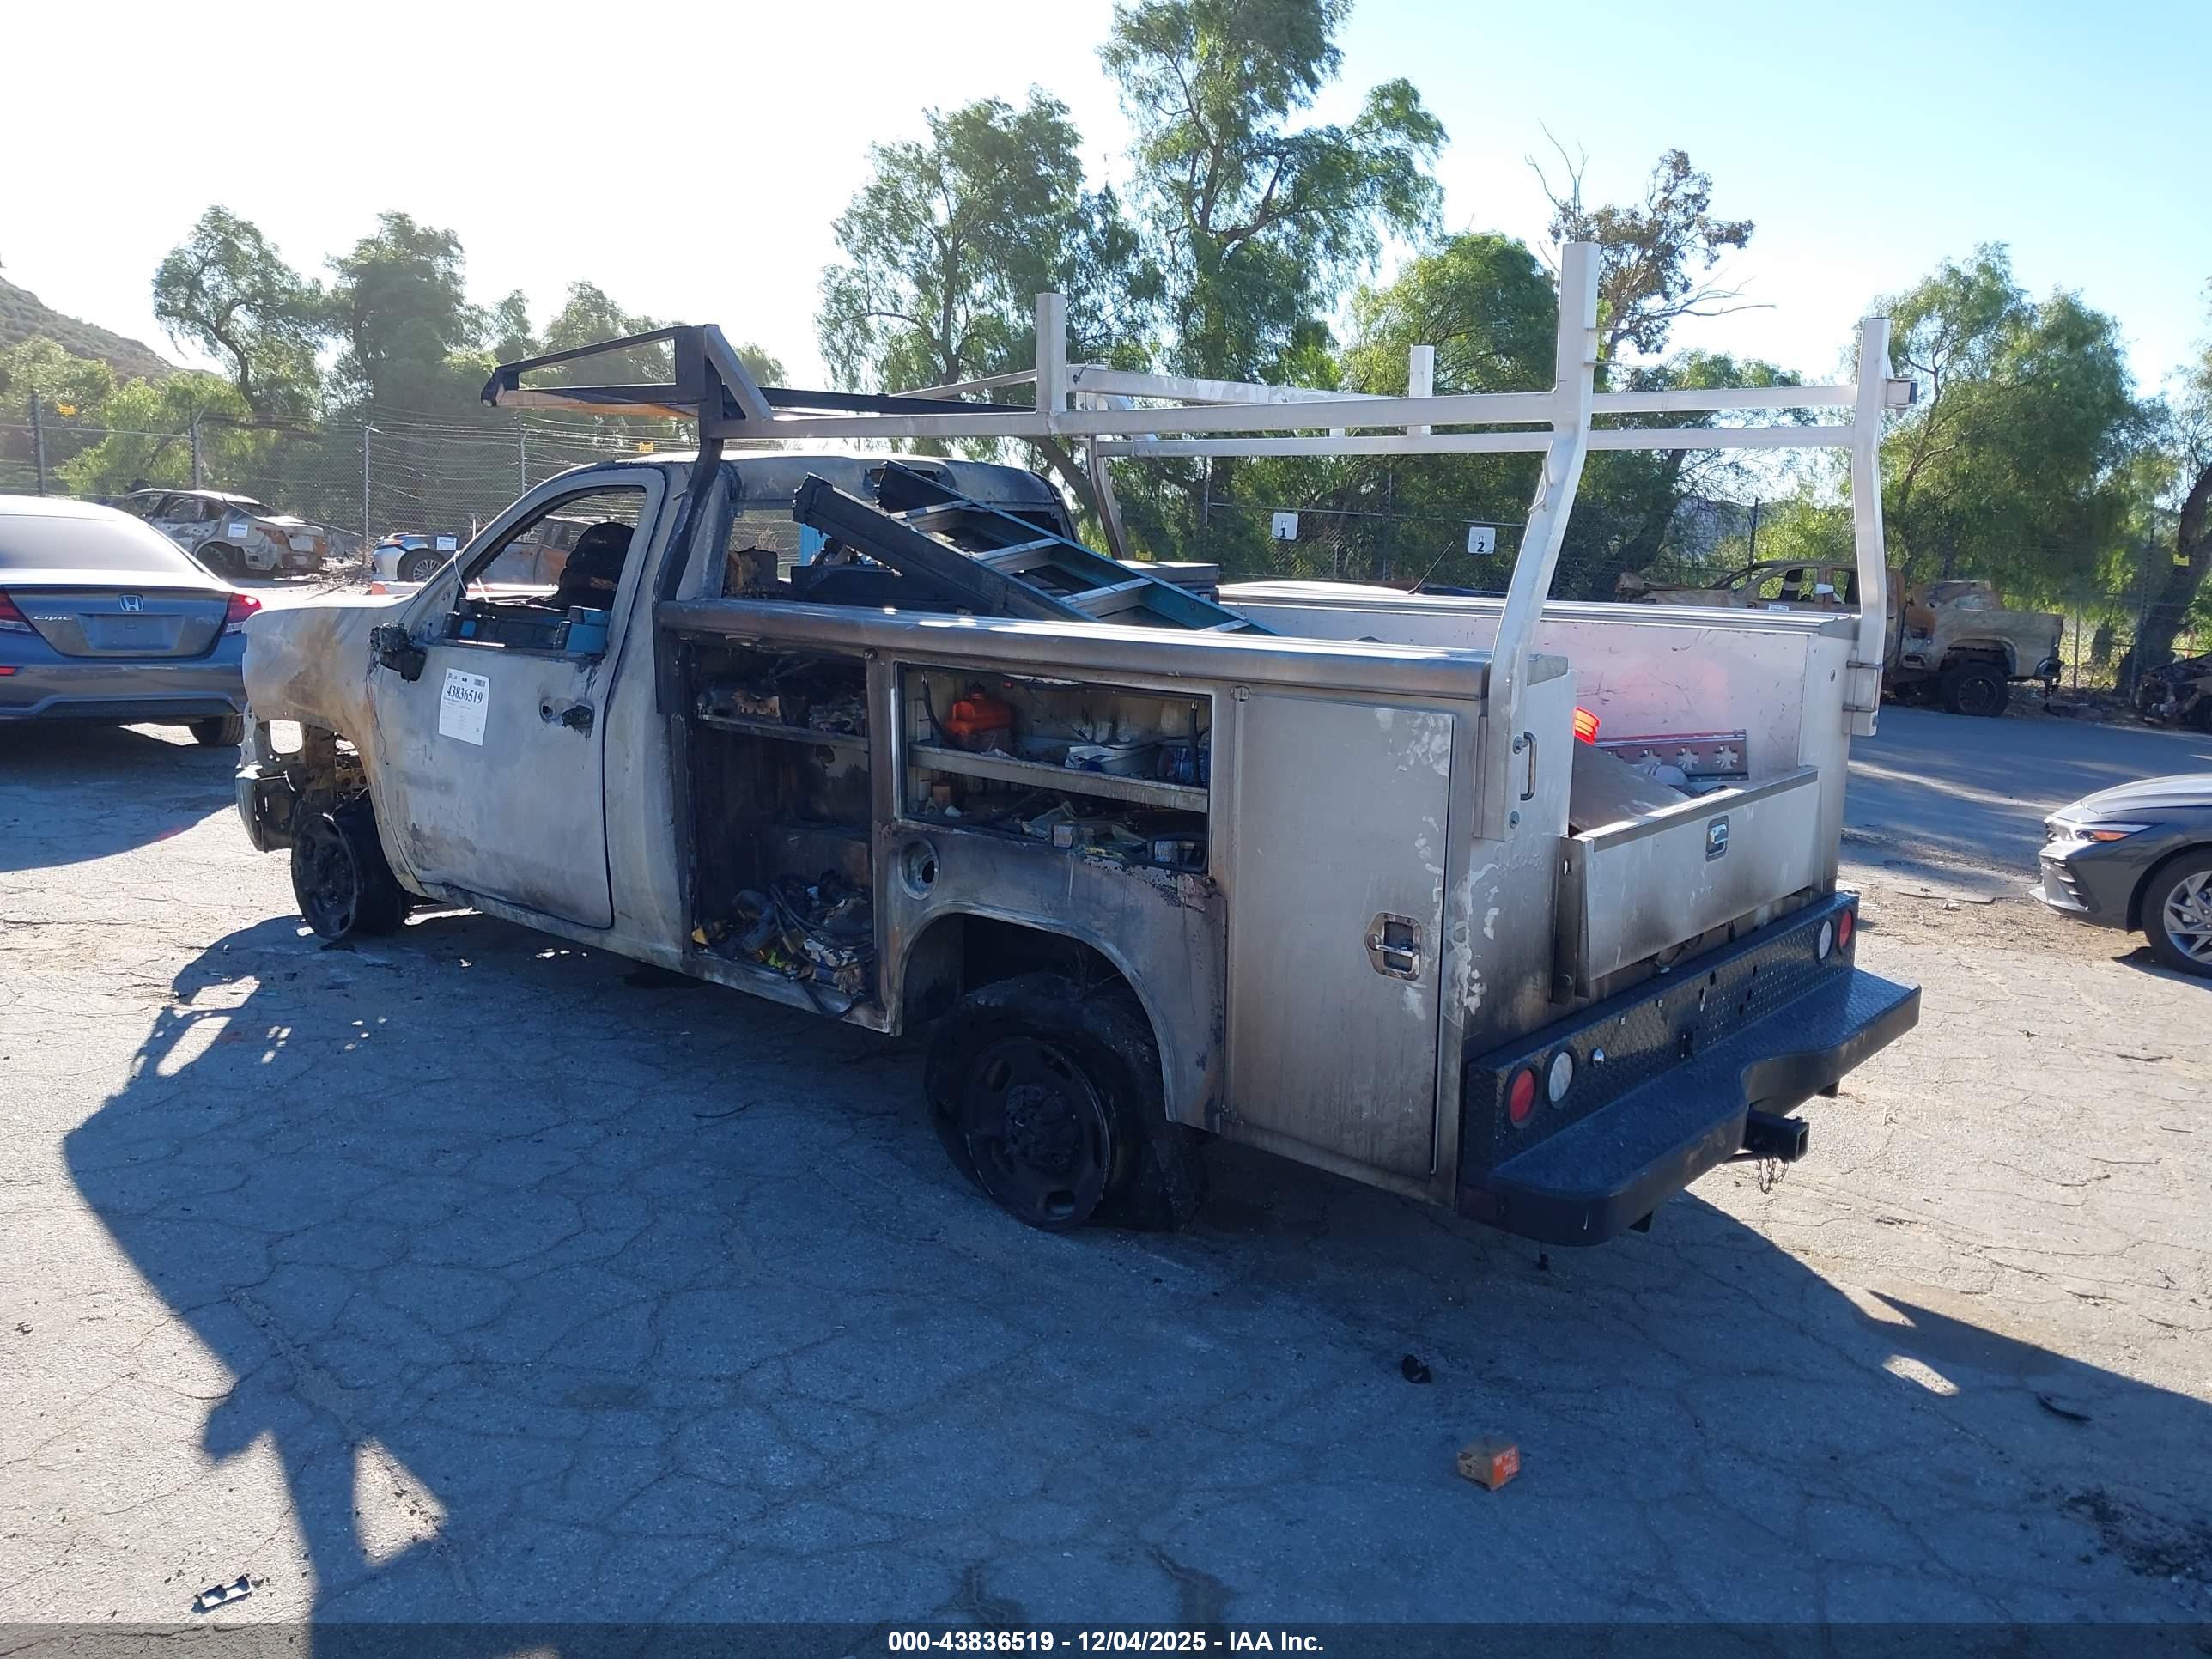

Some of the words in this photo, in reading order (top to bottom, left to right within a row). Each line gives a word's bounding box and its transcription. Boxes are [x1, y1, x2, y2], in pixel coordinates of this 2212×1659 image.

[1279, 527, 1286, 538] 1
[1476, 541, 1485, 552] 2
[447, 685, 483, 704] 43836519
